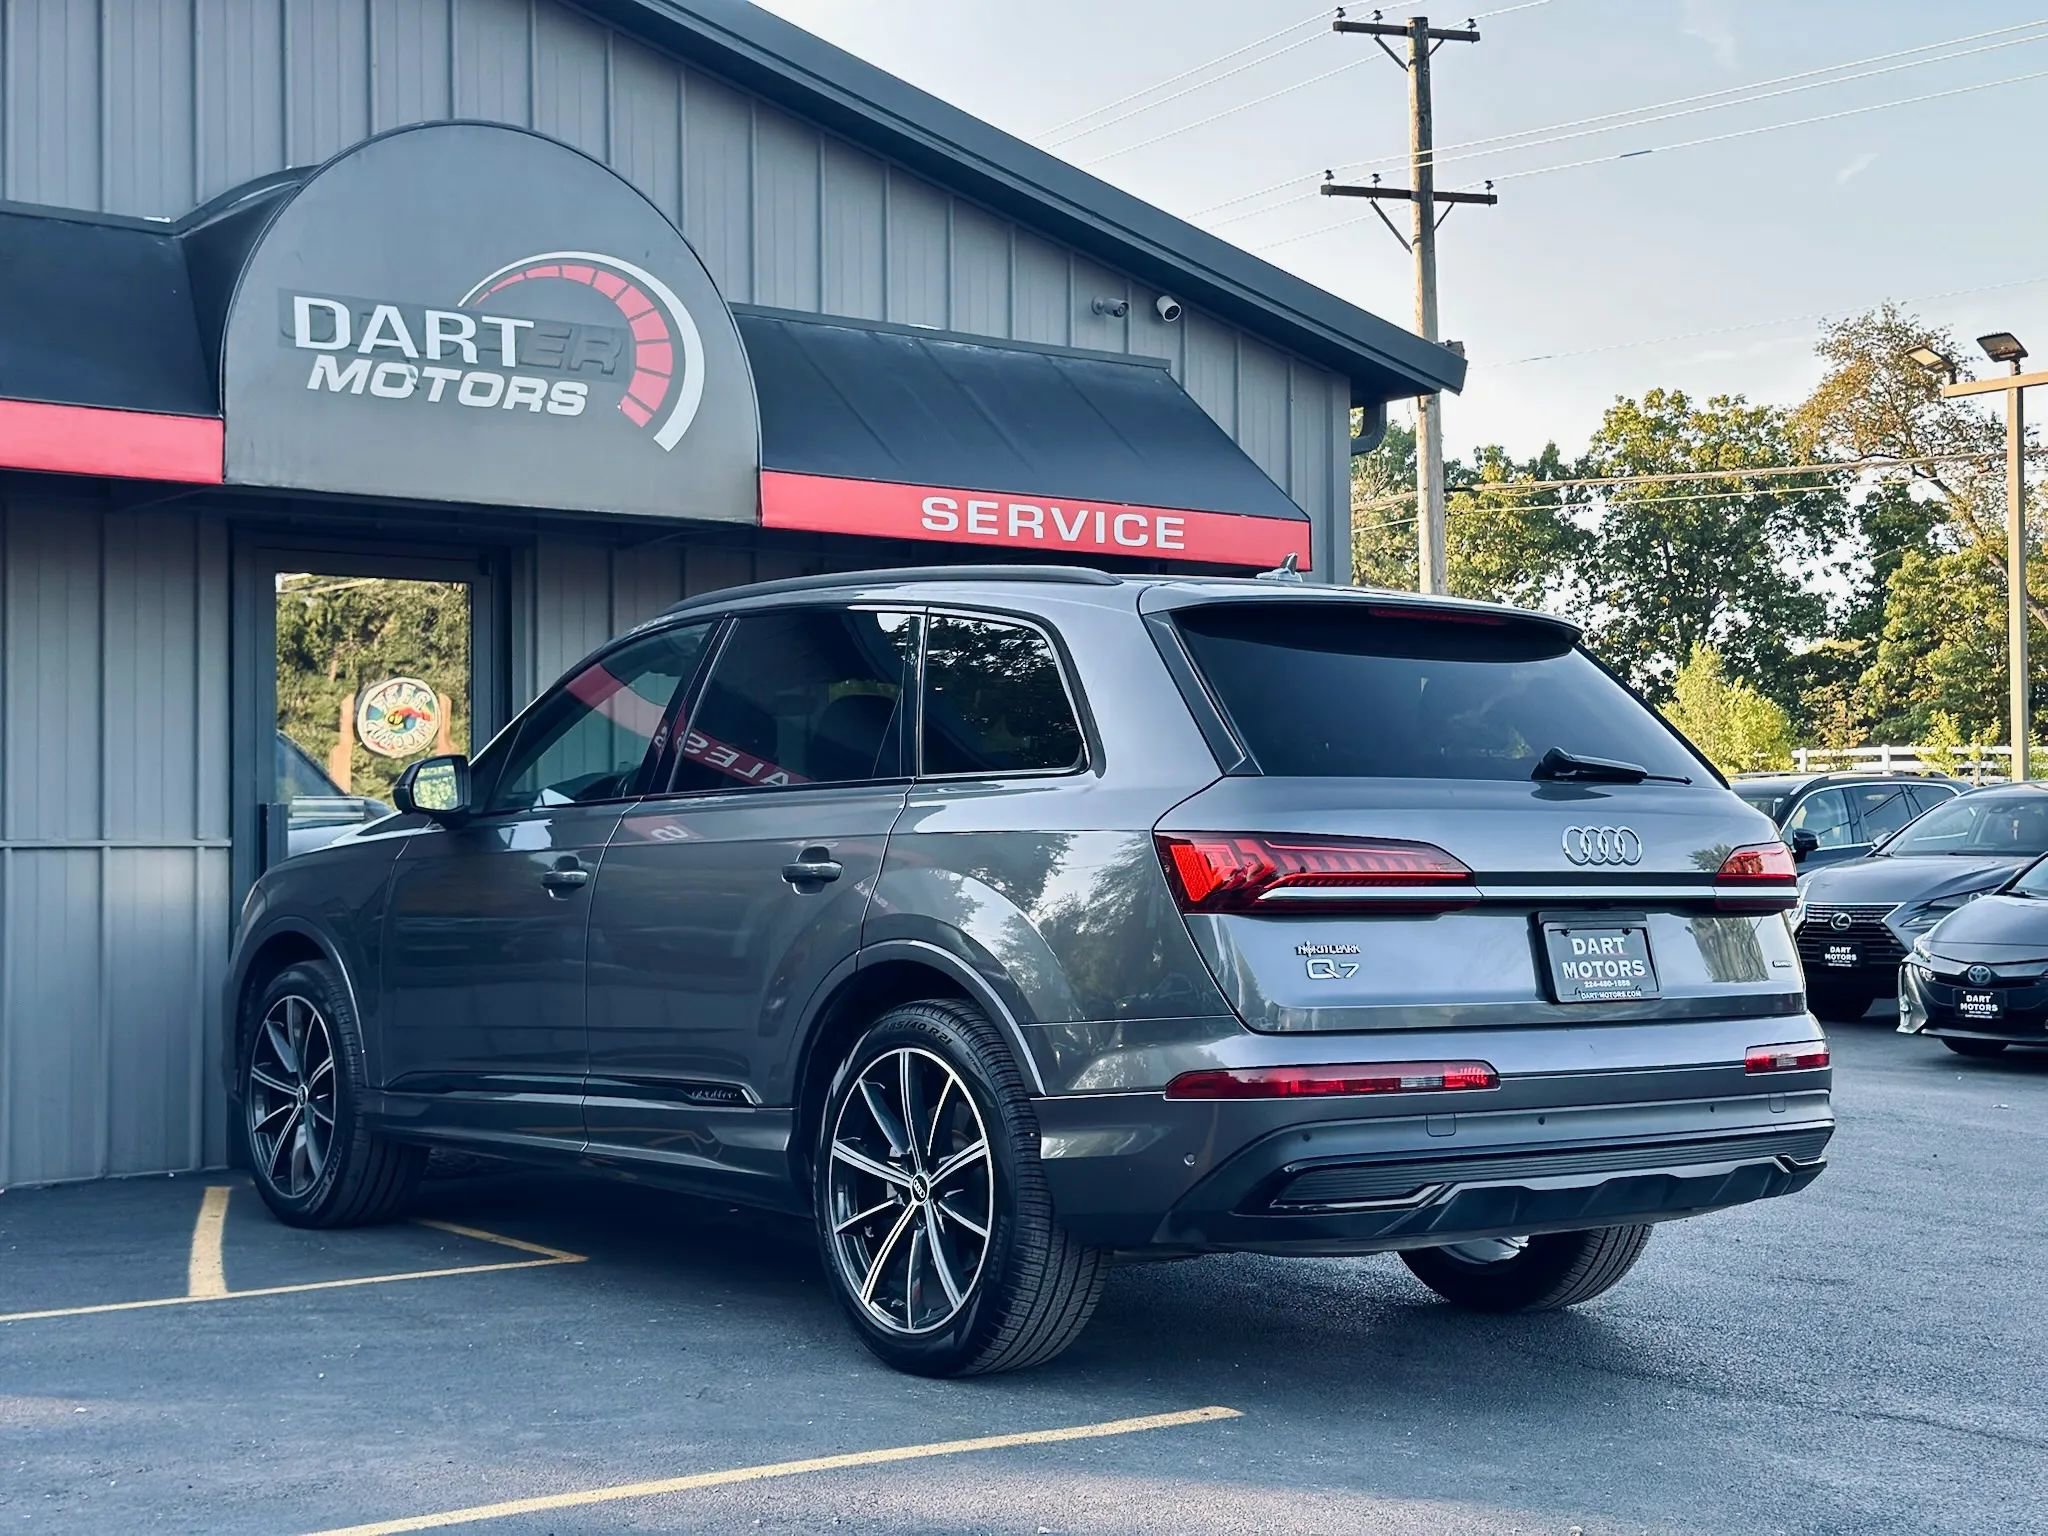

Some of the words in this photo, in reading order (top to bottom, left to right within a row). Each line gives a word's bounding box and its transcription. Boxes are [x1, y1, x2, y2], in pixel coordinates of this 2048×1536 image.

[293, 295, 535, 368] DART
[307, 354, 589, 416] MOTORS
[921, 496, 1185, 550] SERVICE
[1571, 936, 1625, 955] DART
[1824, 953, 1857, 961] MOTORS
[1306, 958, 1360, 979] Q7
[1562, 960, 1646, 979] MOTORS
[1960, 1002, 1999, 1012] MOTORS
[1966, 994, 1991, 1003] DART
